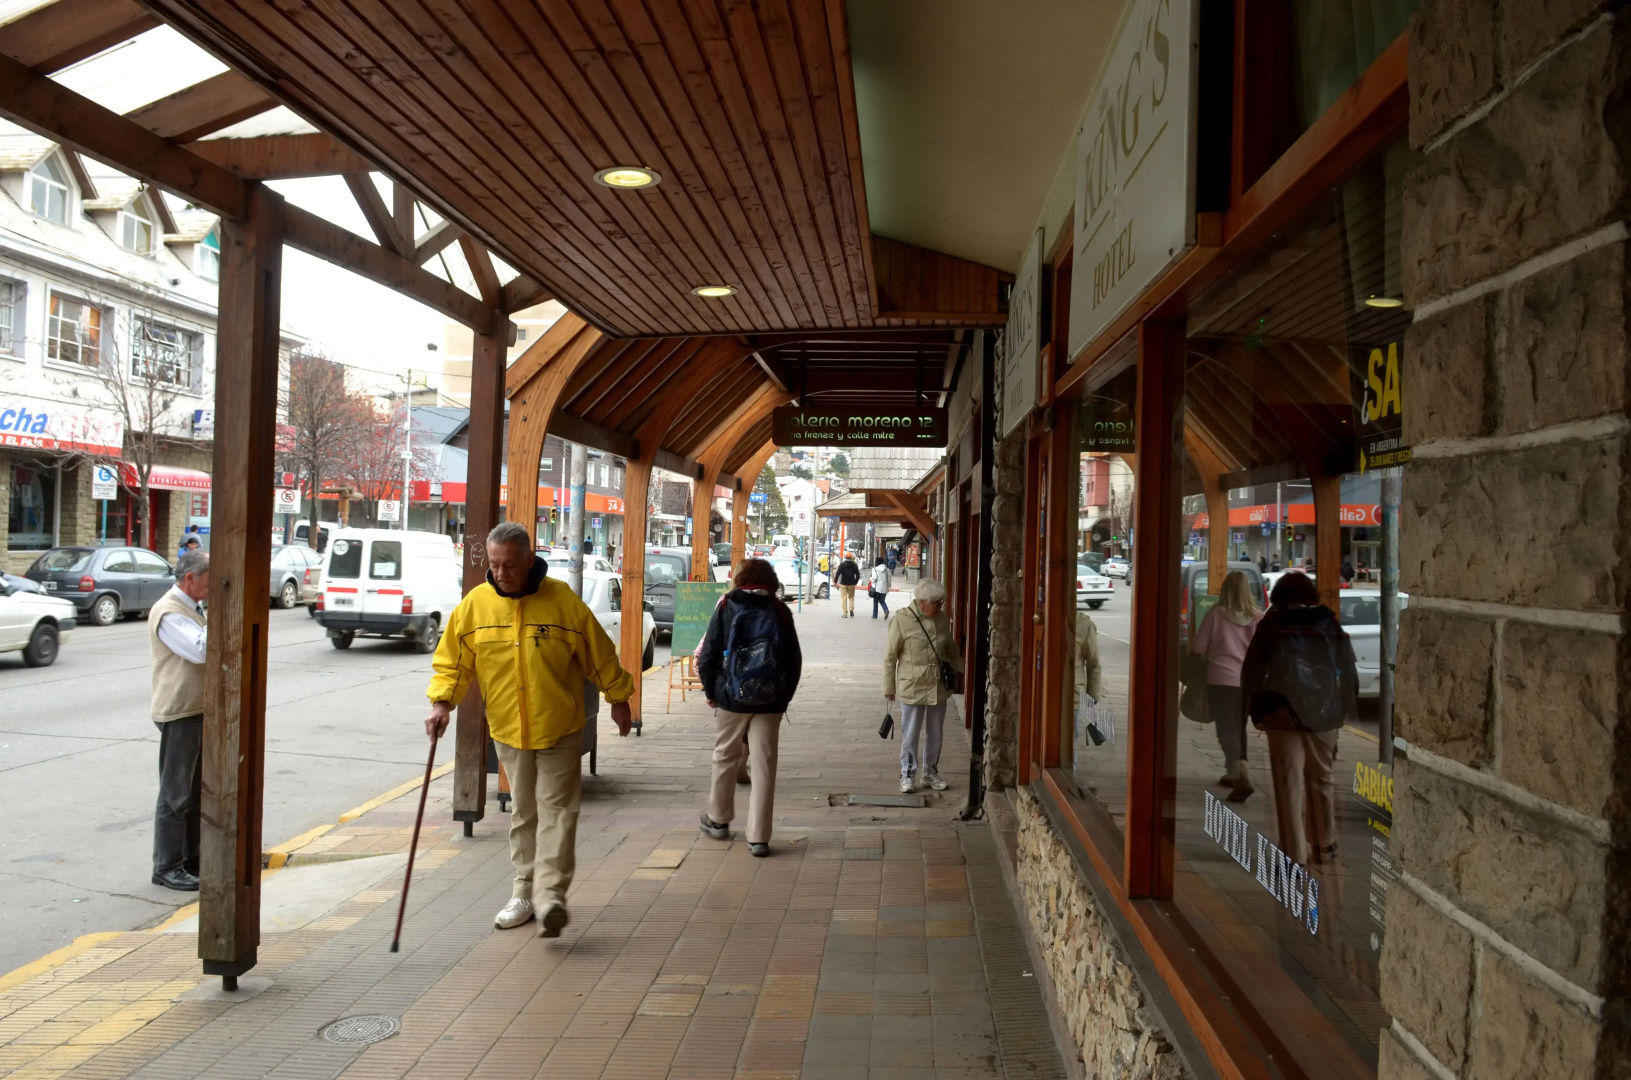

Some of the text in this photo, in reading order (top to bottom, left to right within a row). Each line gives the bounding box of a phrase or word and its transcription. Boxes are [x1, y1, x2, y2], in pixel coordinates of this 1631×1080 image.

[1083, 0, 1170, 233] KING'S
[1092, 217, 1136, 311] HOTEL
[1007, 274, 1033, 364] KING'S
[790, 413, 840, 427] aleria
[847, 416, 912, 428] moreno
[1361, 341, 1403, 425] ¿SA
[804, 431, 834, 439] firenze
[847, 431, 869, 439] calle
[872, 431, 895, 439] mitre
[607, 502, 618, 511] 24
[1204, 790, 1319, 935] HOTEL KING'S
